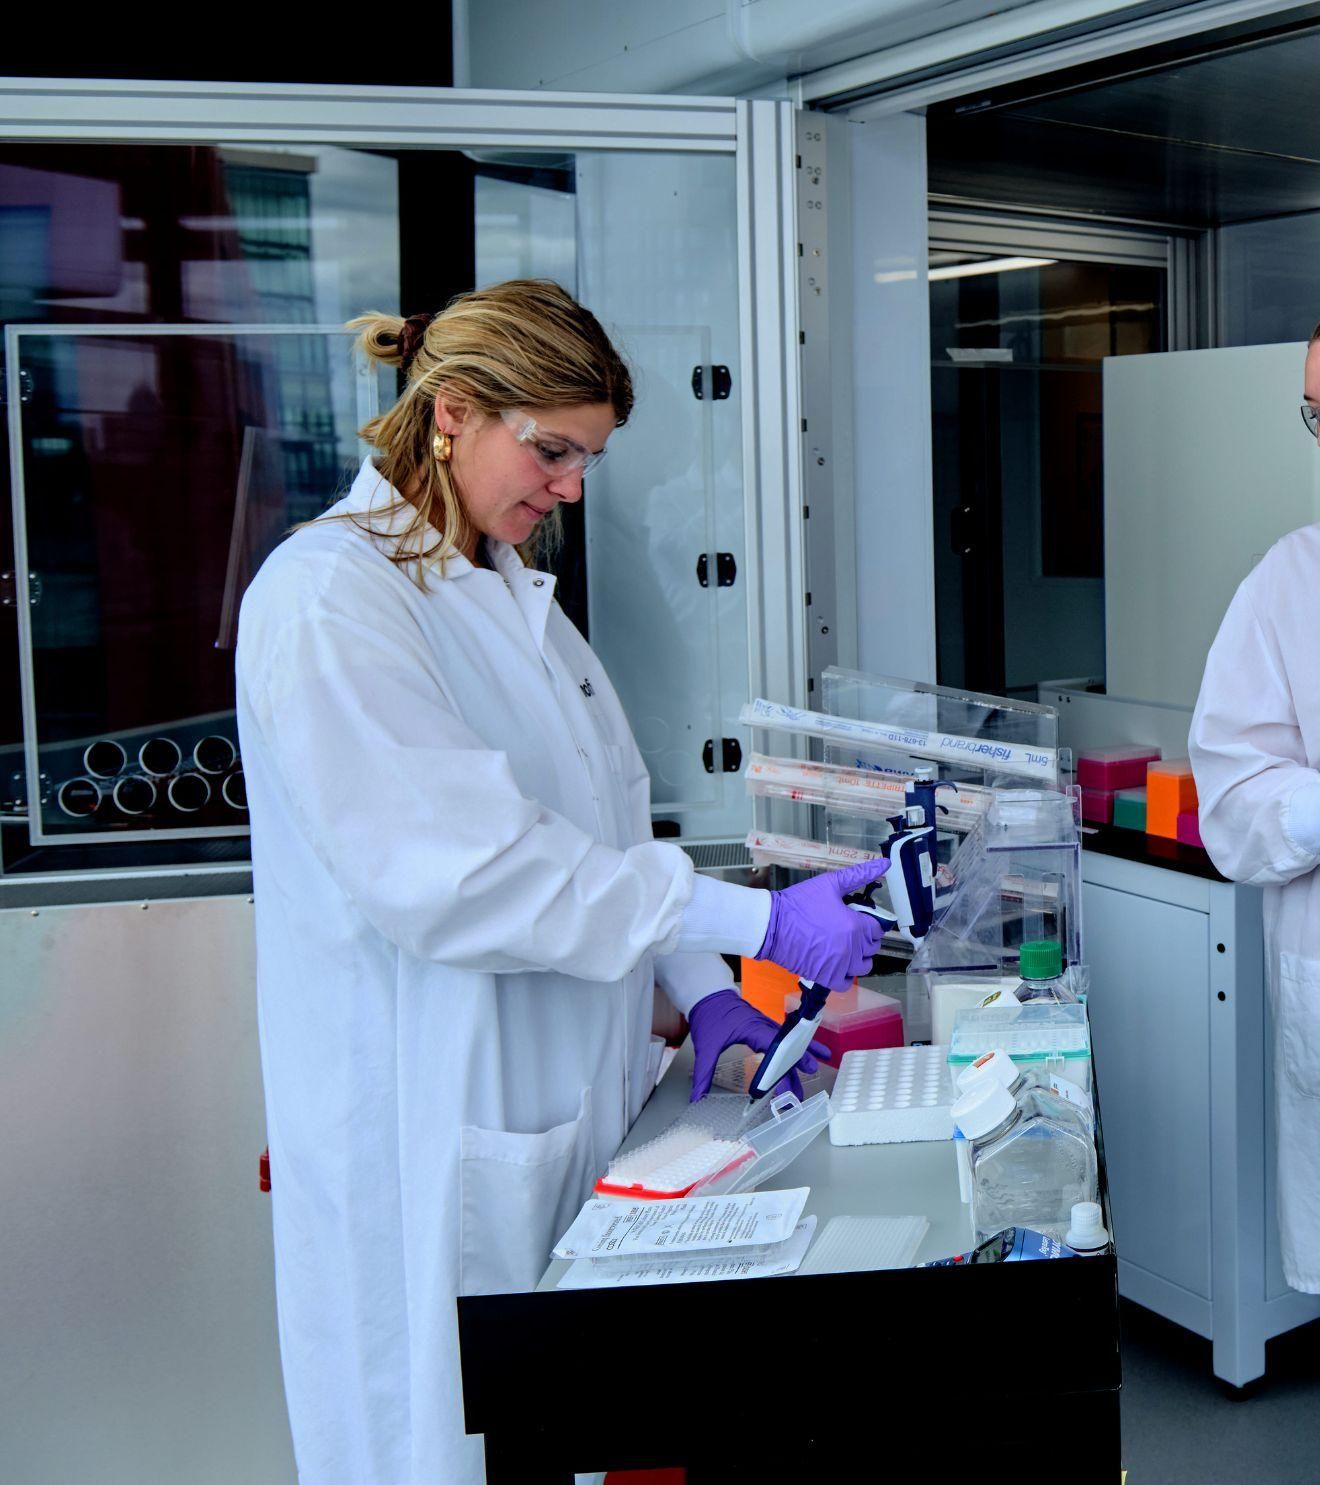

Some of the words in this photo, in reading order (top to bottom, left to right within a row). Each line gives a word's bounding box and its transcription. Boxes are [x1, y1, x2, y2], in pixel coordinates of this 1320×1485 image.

[940, 737, 1012, 761] fisherbrand
[1025, 752, 1049, 767] 5mL
[865, 779, 906, 793] TRIPETTE
